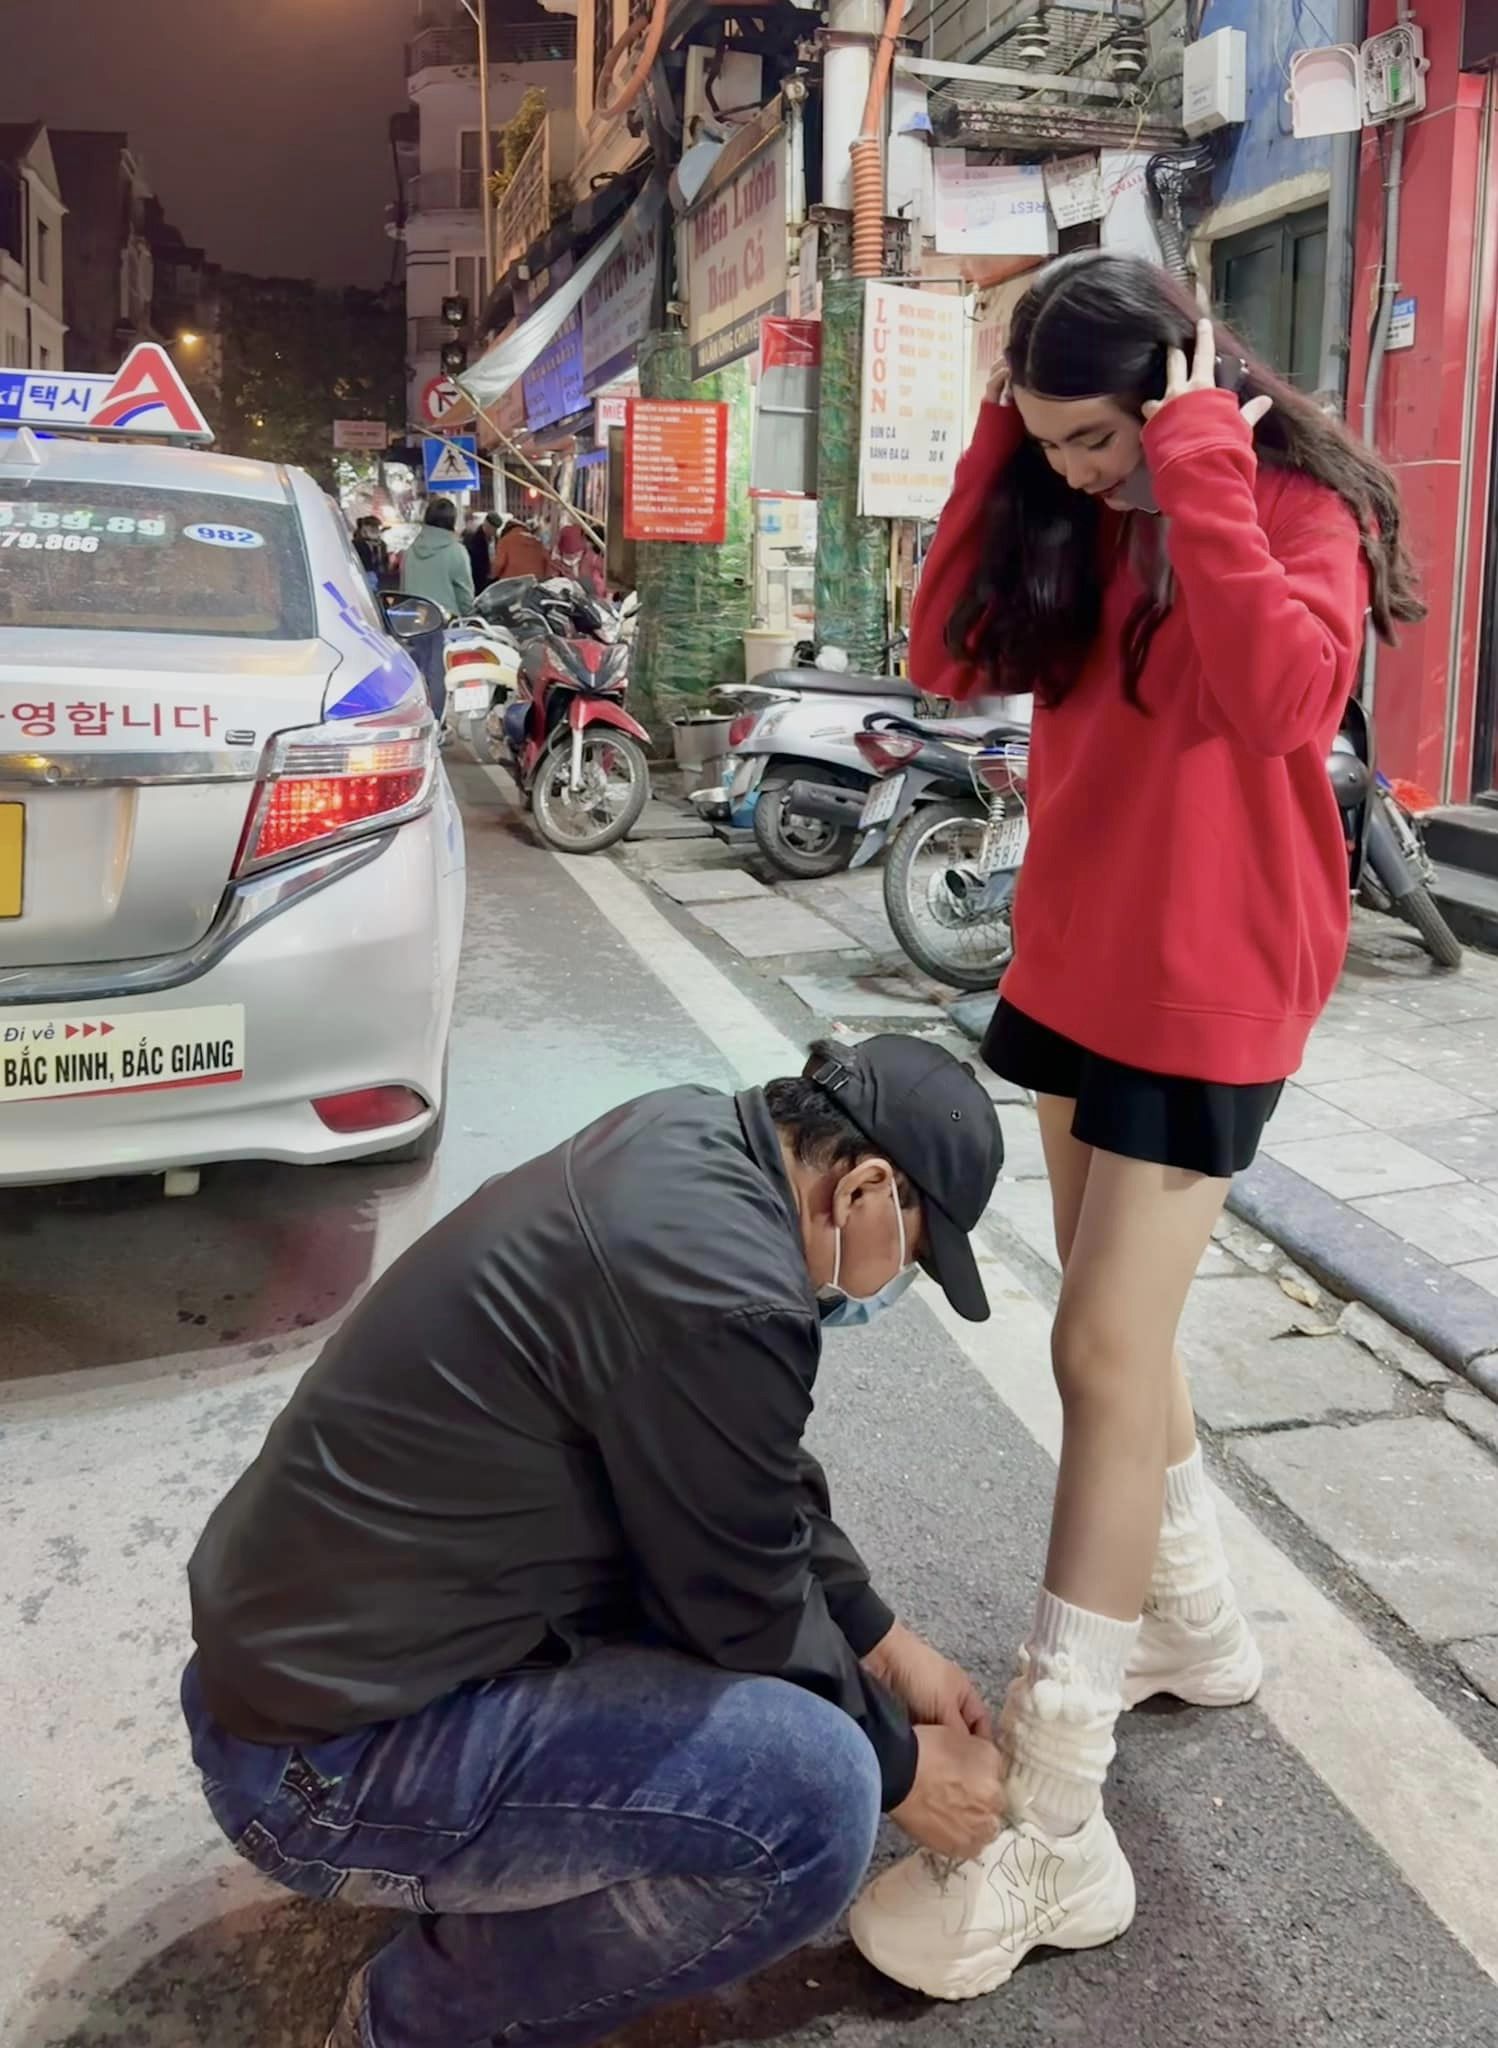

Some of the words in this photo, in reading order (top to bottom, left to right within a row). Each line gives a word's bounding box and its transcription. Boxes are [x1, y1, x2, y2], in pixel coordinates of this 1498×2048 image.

[30, 385, 91, 412] 택시
[197, 527, 255, 544] 982
[0, 702, 218, 737] 영합니다
[4, 1027, 25, 1042] Đi
[32, 1022, 55, 1040] về
[4, 1046, 48, 1087] BẮC
[55, 1051, 114, 1083] NINH,
[122, 1037, 163, 1078] BẮC
[171, 1040, 234, 1072] GIANG
